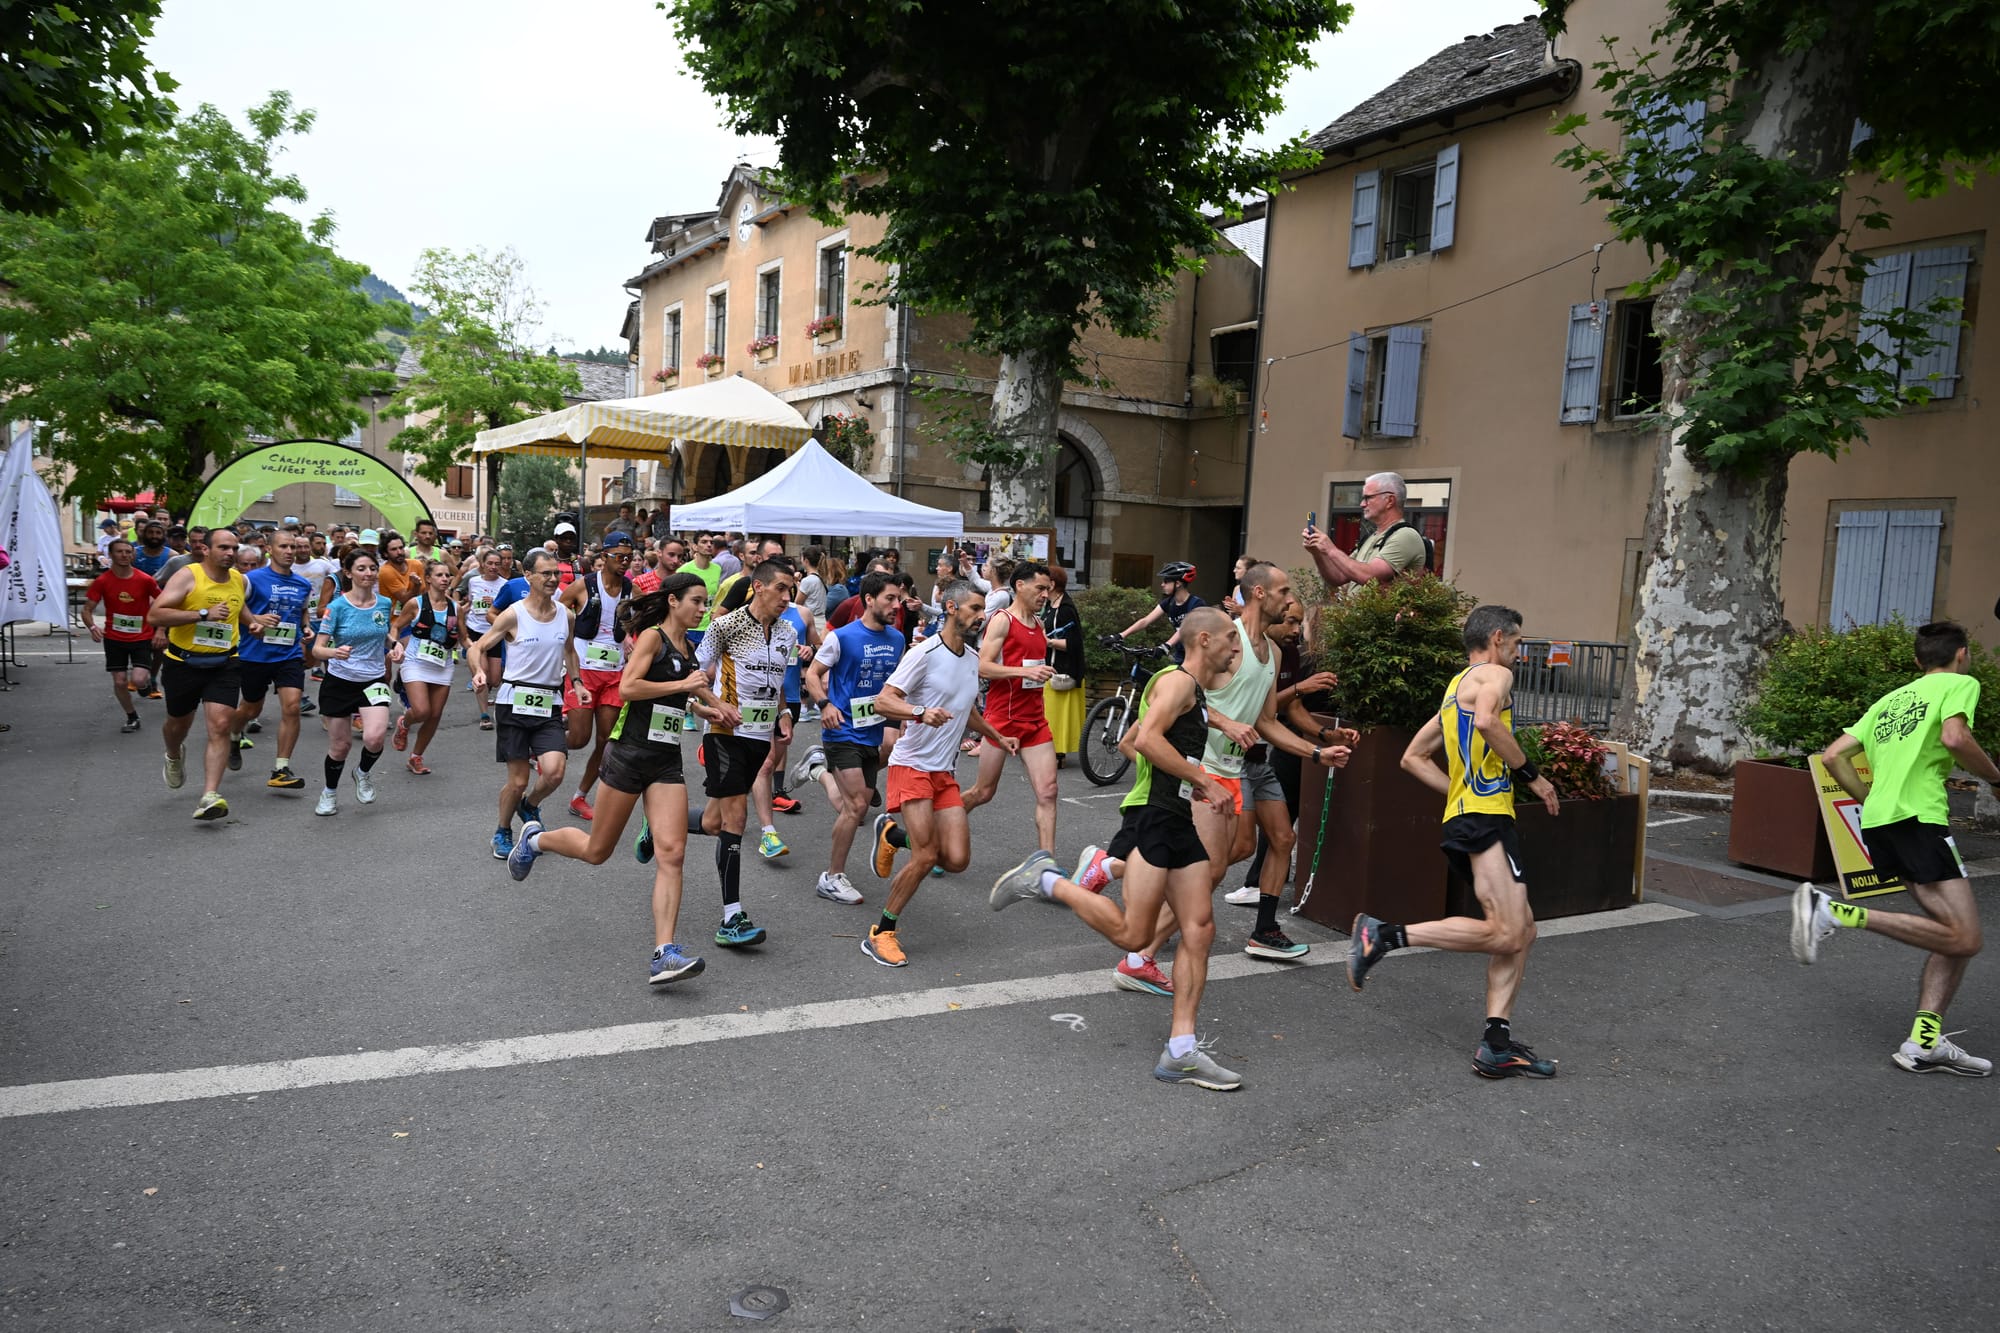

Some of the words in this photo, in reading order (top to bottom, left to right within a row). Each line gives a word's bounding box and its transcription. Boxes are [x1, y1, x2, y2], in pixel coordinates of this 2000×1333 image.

[788, 349, 860, 386] MAIRIE
[268, 453, 332, 469] Challenge
[338, 457, 359, 466] des
[260, 464, 306, 475] vallées
[313, 467, 367, 476] cévenoles
[432, 510, 476, 522] OUCHERIE
[119, 619, 135, 628] 94
[206, 627, 224, 640] 15
[274, 627, 290, 638] 77
[424, 645, 445, 659] 128
[599, 649, 609, 661] 2
[373, 687, 391, 697] 74
[524, 694, 544, 708] 82
[751, 708, 770, 722] 76
[857, 703, 876, 717] 10
[662, 716, 680, 733] 56
[1229, 741, 1245, 757] 11
[1821, 783, 1841, 794] ESTRE
